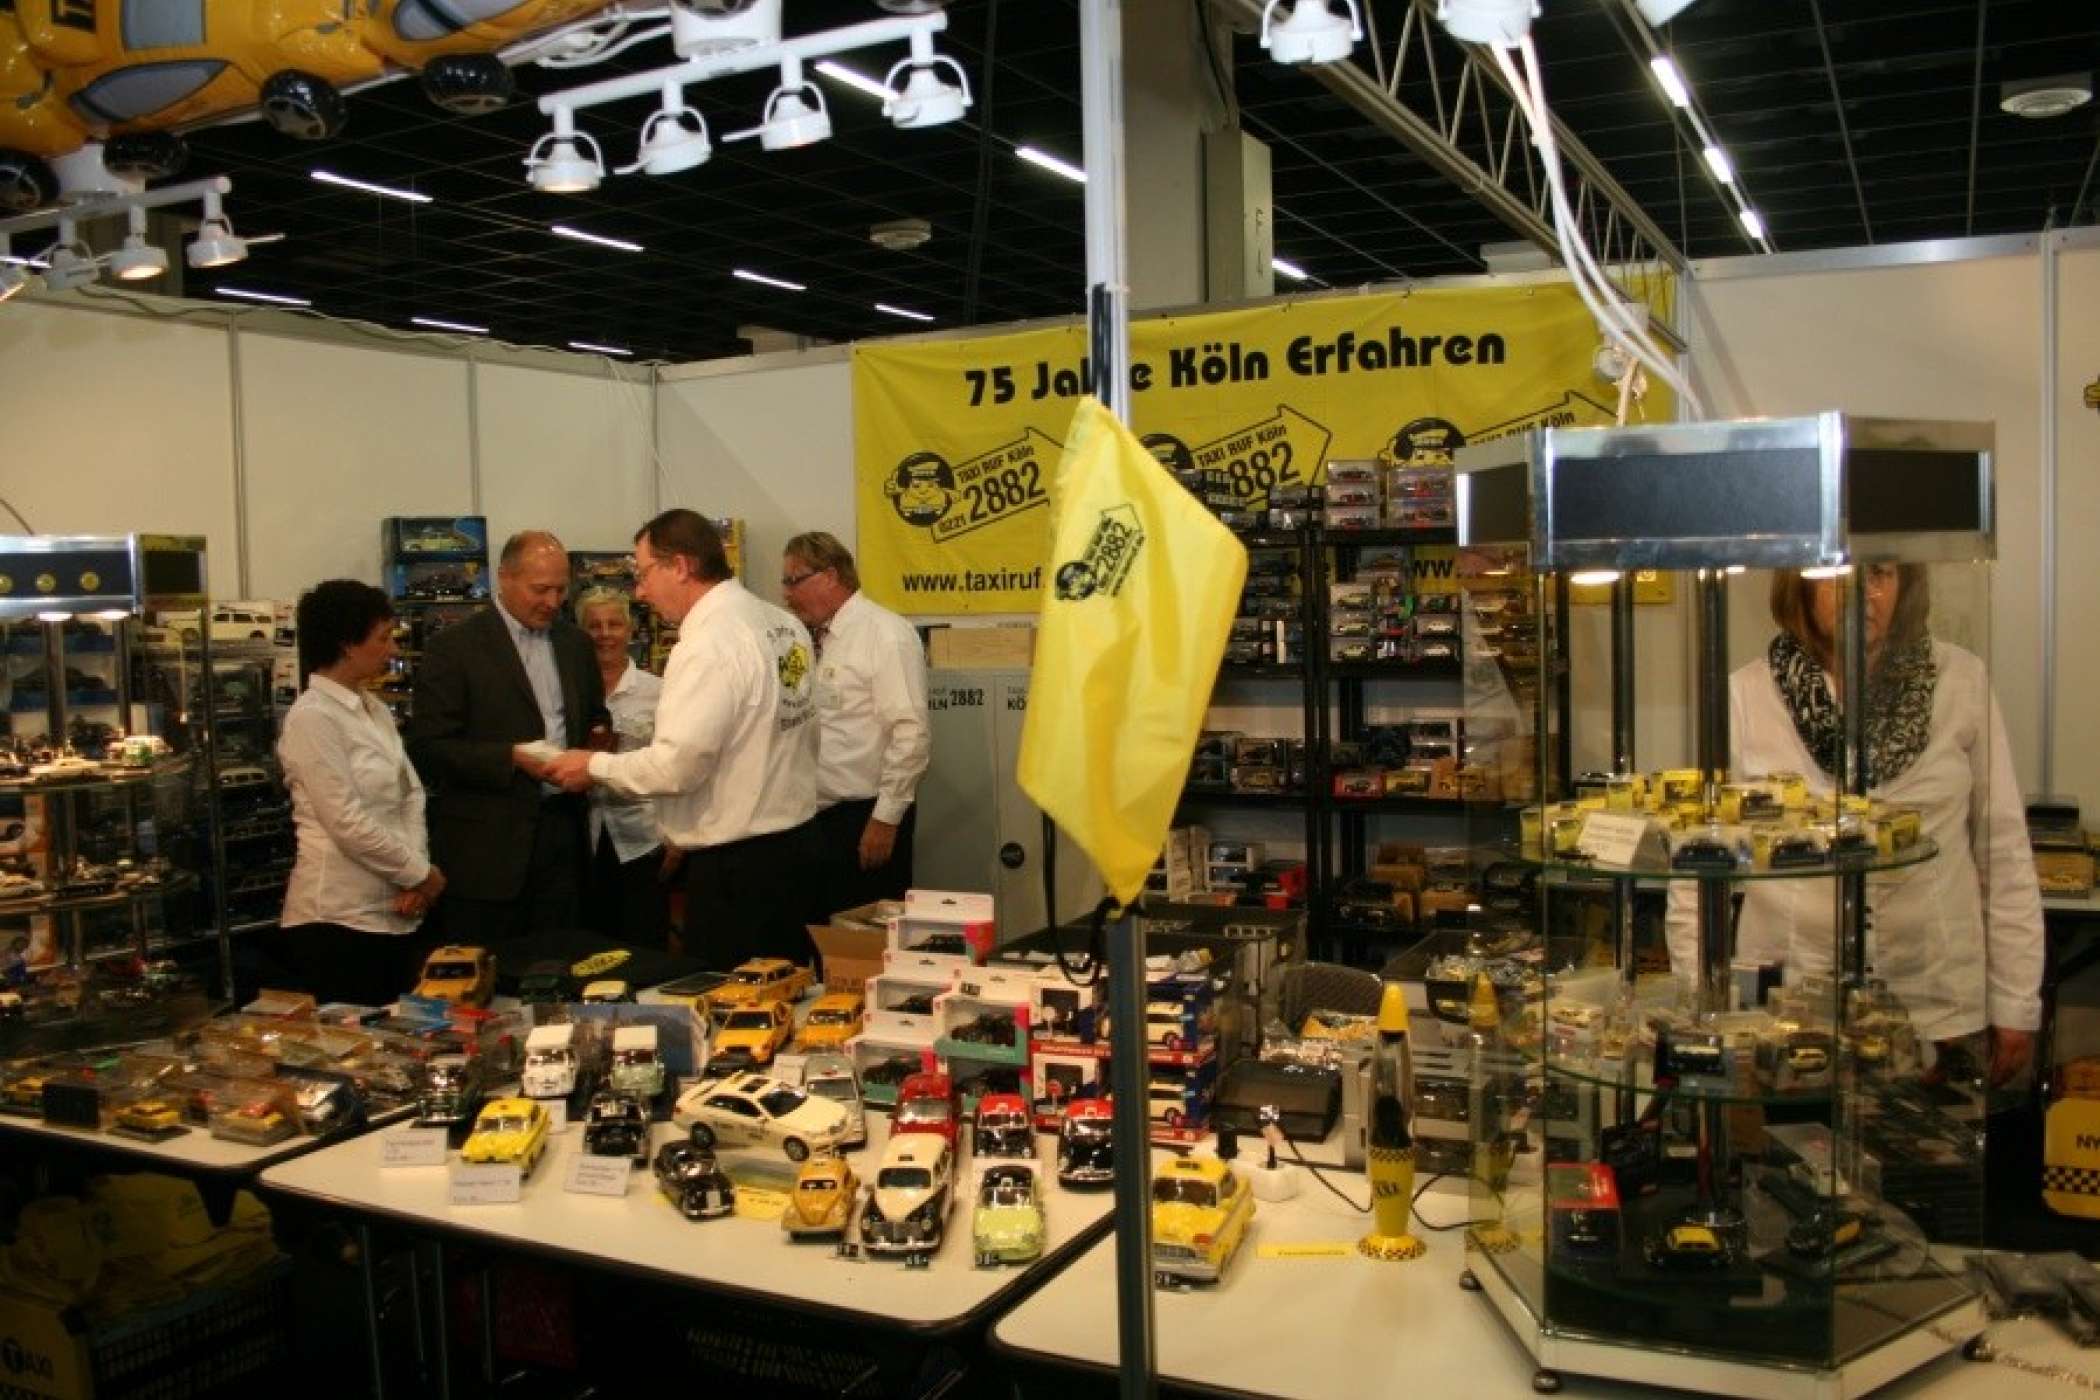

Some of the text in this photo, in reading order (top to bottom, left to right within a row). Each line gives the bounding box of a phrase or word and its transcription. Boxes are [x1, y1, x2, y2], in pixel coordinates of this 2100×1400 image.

[965, 326, 1506, 406] 75 Jae Köln Erfahren
[963, 460, 1047, 522] 2882
[1228, 440, 1301, 498] 882
[1094, 521, 1134, 589] 2882
[950, 687, 985, 706] 2882
